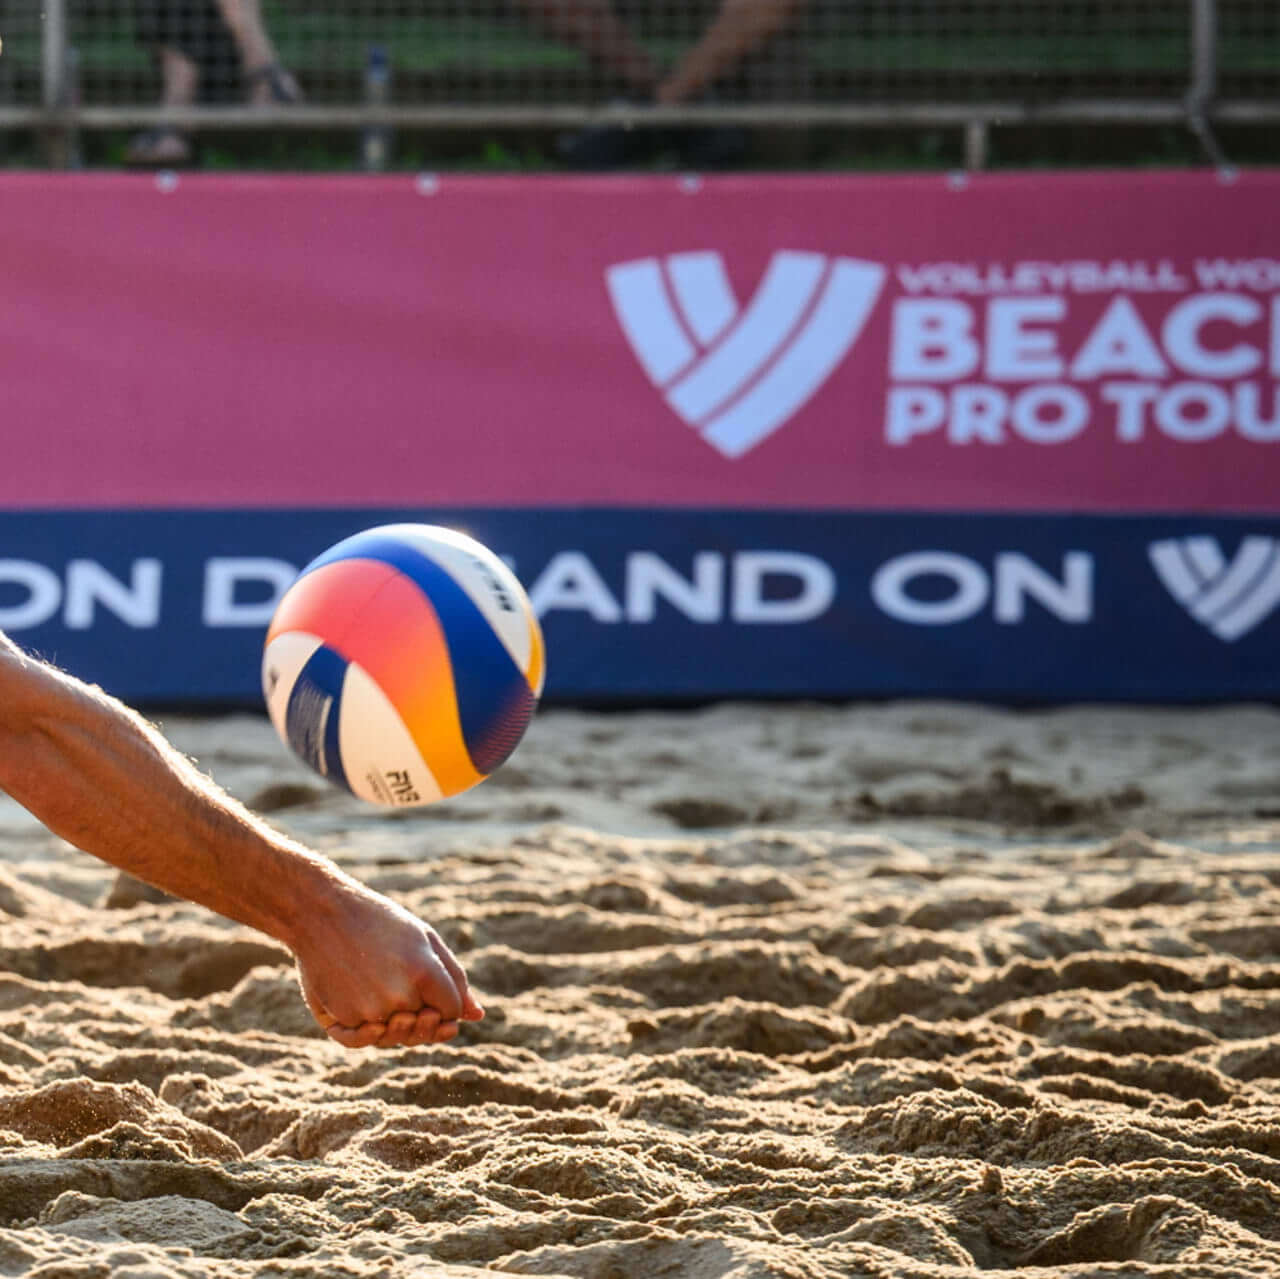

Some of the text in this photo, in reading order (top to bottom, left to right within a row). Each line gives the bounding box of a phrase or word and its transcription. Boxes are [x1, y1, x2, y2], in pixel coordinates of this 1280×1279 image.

[896, 261, 1188, 295] VOLLEYBALL
[888, 292, 1280, 382] BEAC
[885, 382, 1090, 445] PRO
[202, 554, 836, 625] DAND
[870, 550, 1095, 626] ON
